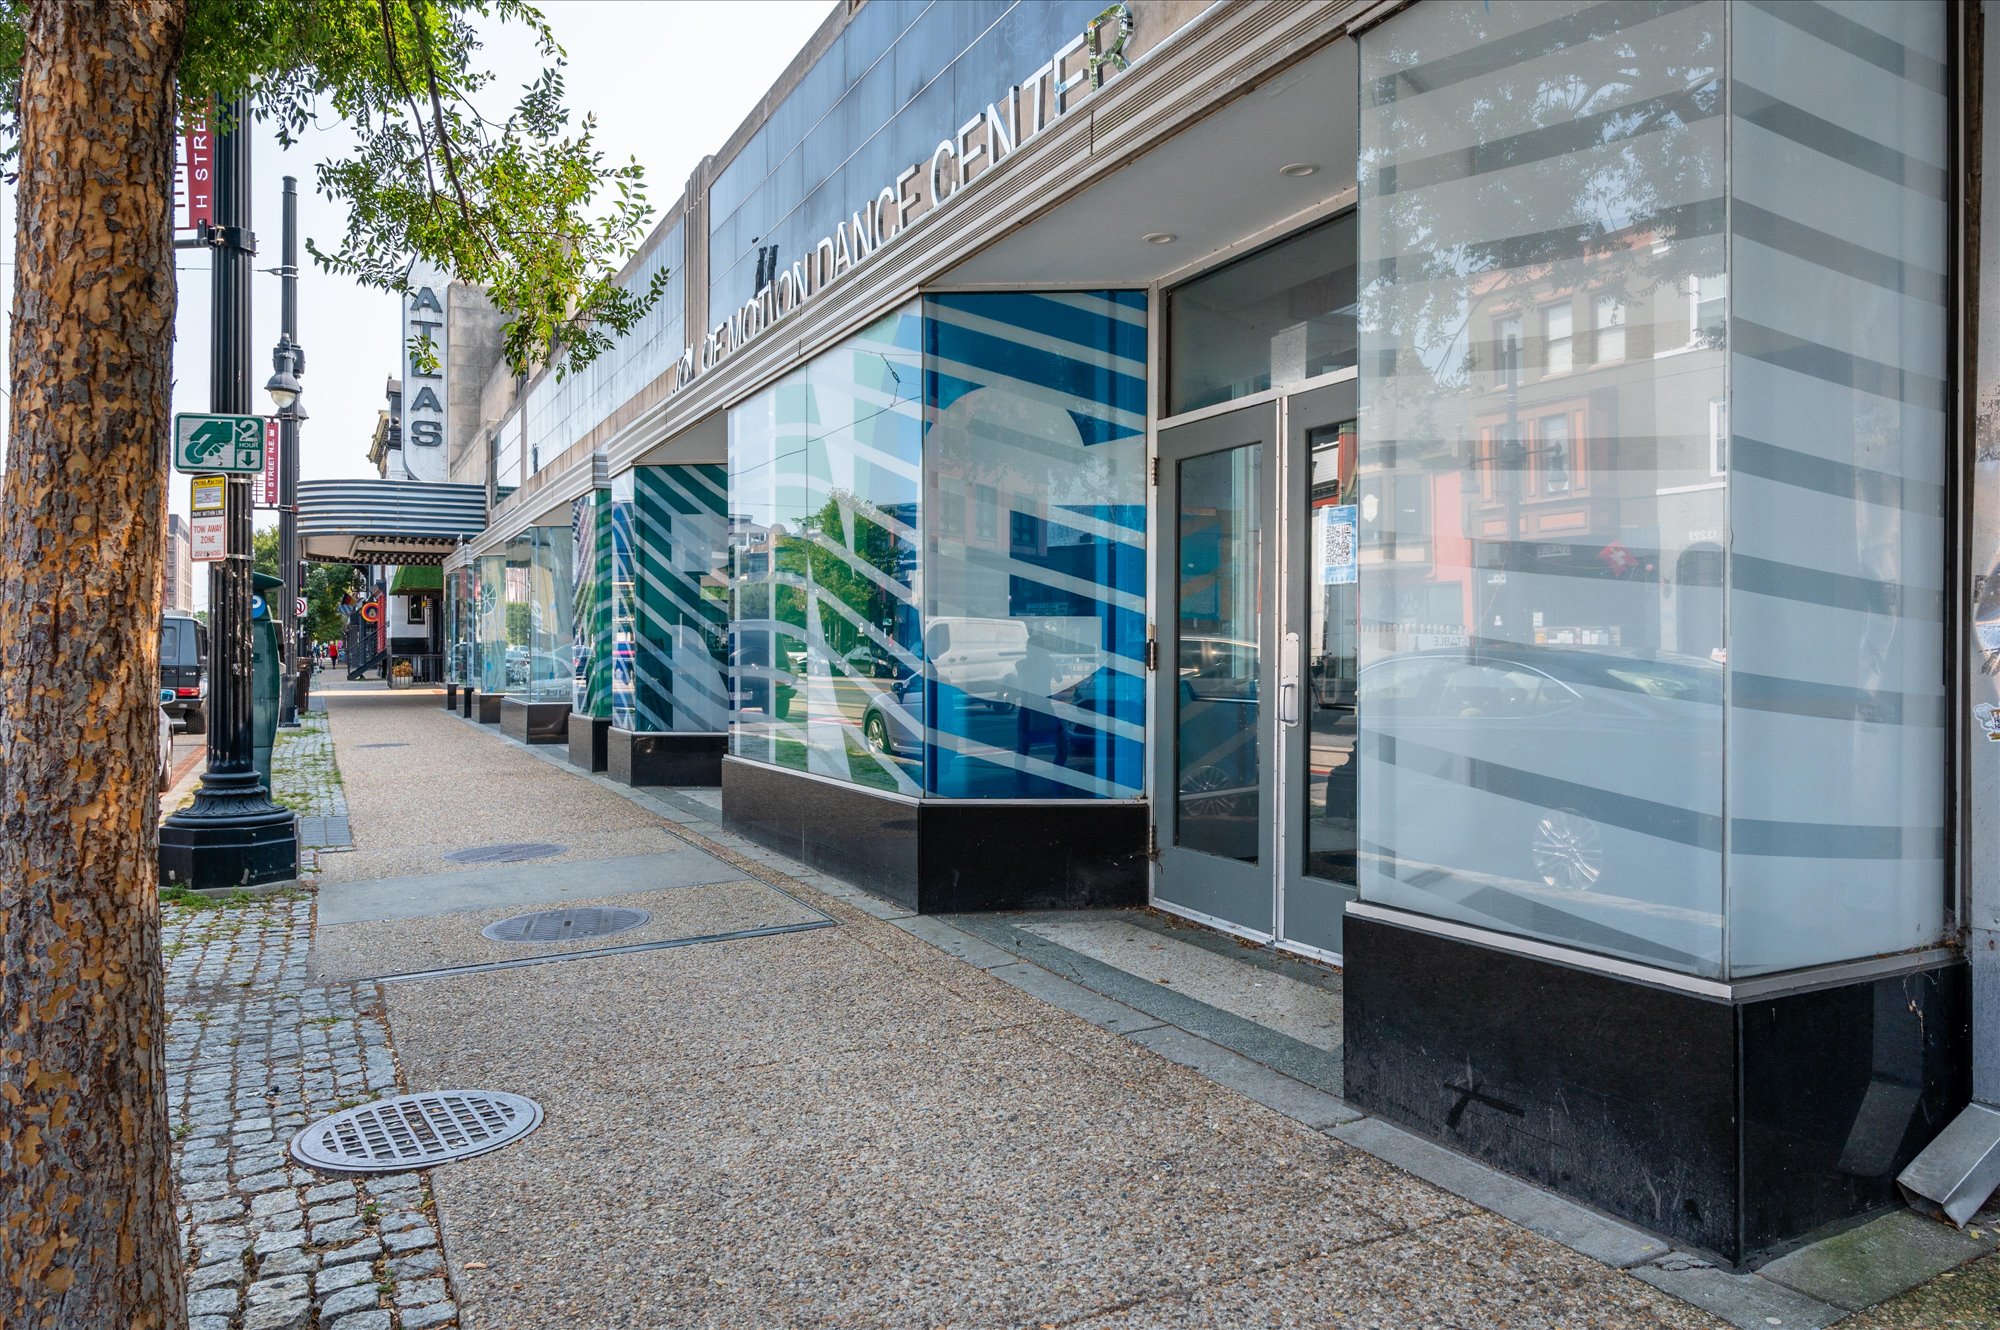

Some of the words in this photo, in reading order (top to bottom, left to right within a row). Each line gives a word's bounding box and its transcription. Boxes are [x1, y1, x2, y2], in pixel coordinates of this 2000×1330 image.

[702, 322, 727, 373] OF
[728, 252, 811, 354] MOTION
[818, 164, 920, 287] DANCE
[930, 3, 1133, 208] CENTER
[196, 195, 208, 208] H
[409, 286, 443, 447] ATLAS
[239, 420, 258, 442] 2
[194, 525, 206, 533] TOW
[208, 524, 222, 532] AWAY
[200, 536, 215, 544] ZONE
